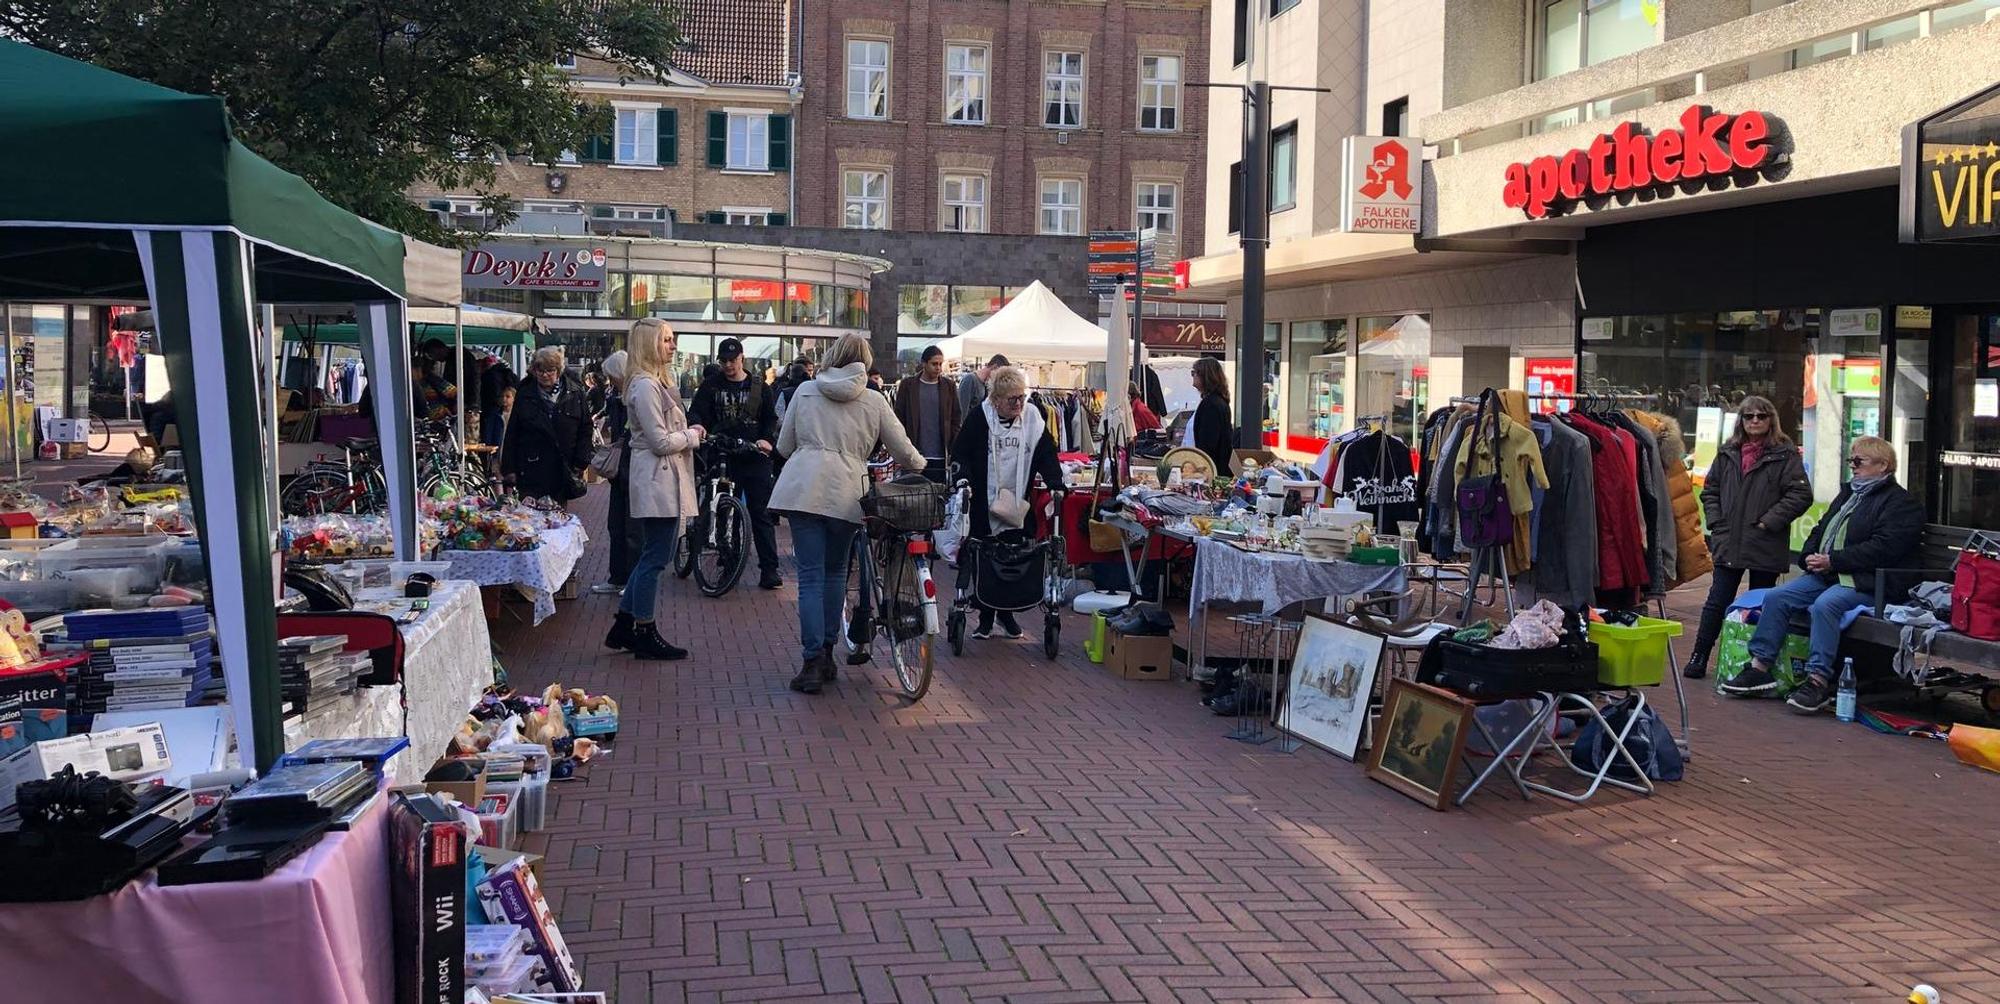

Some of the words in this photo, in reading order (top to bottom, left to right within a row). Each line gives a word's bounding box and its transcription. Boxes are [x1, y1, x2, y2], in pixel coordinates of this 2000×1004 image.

[1503, 104, 1769, 218] apotheke
[1354, 218, 1417, 230] APOTHEKE
[1363, 207, 1410, 218] FALKEN
[464, 250, 579, 286] Deyck's
[0, 711, 21, 722] ation
[436, 894, 454, 933] Wii
[439, 957, 451, 992] ROCK
